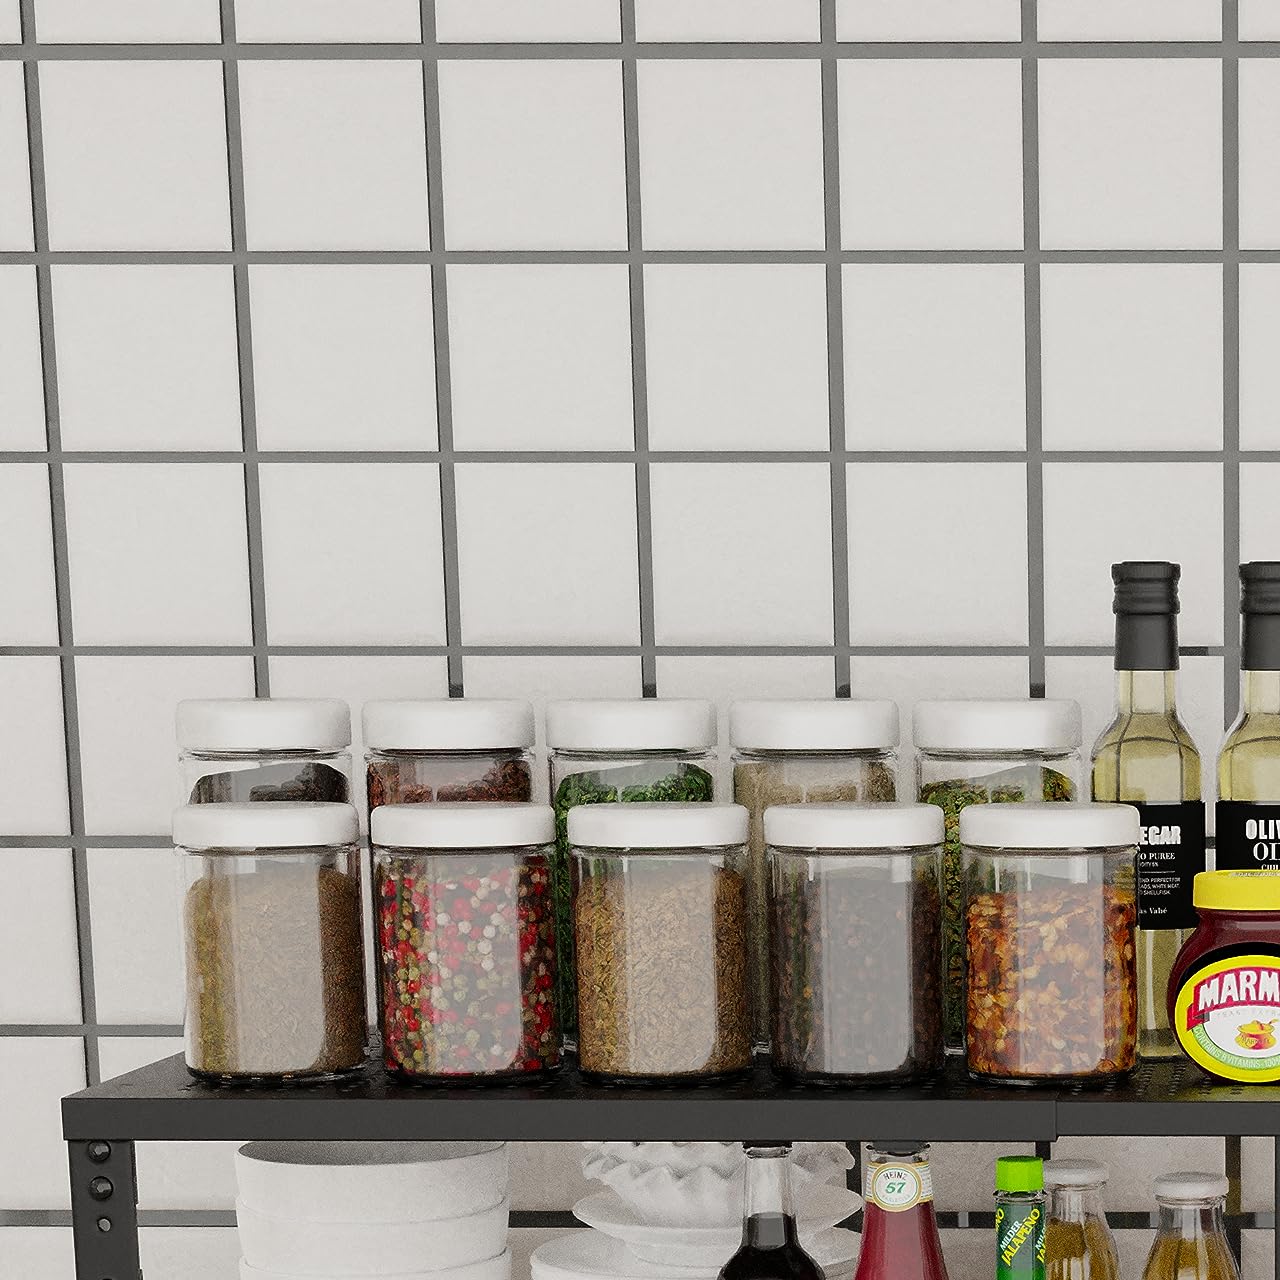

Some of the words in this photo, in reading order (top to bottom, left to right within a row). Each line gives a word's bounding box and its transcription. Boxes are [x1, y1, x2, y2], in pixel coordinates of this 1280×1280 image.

[1140, 826, 1181, 845] EGAR
[1149, 852, 1176, 860] PUREE
[1226, 1056, 1261, 1068] VITAMINS
[884, 1171, 908, 1181] HEINZ
[885, 1182, 906, 1194] 57
[1000, 1220, 1022, 1251] MILDER
